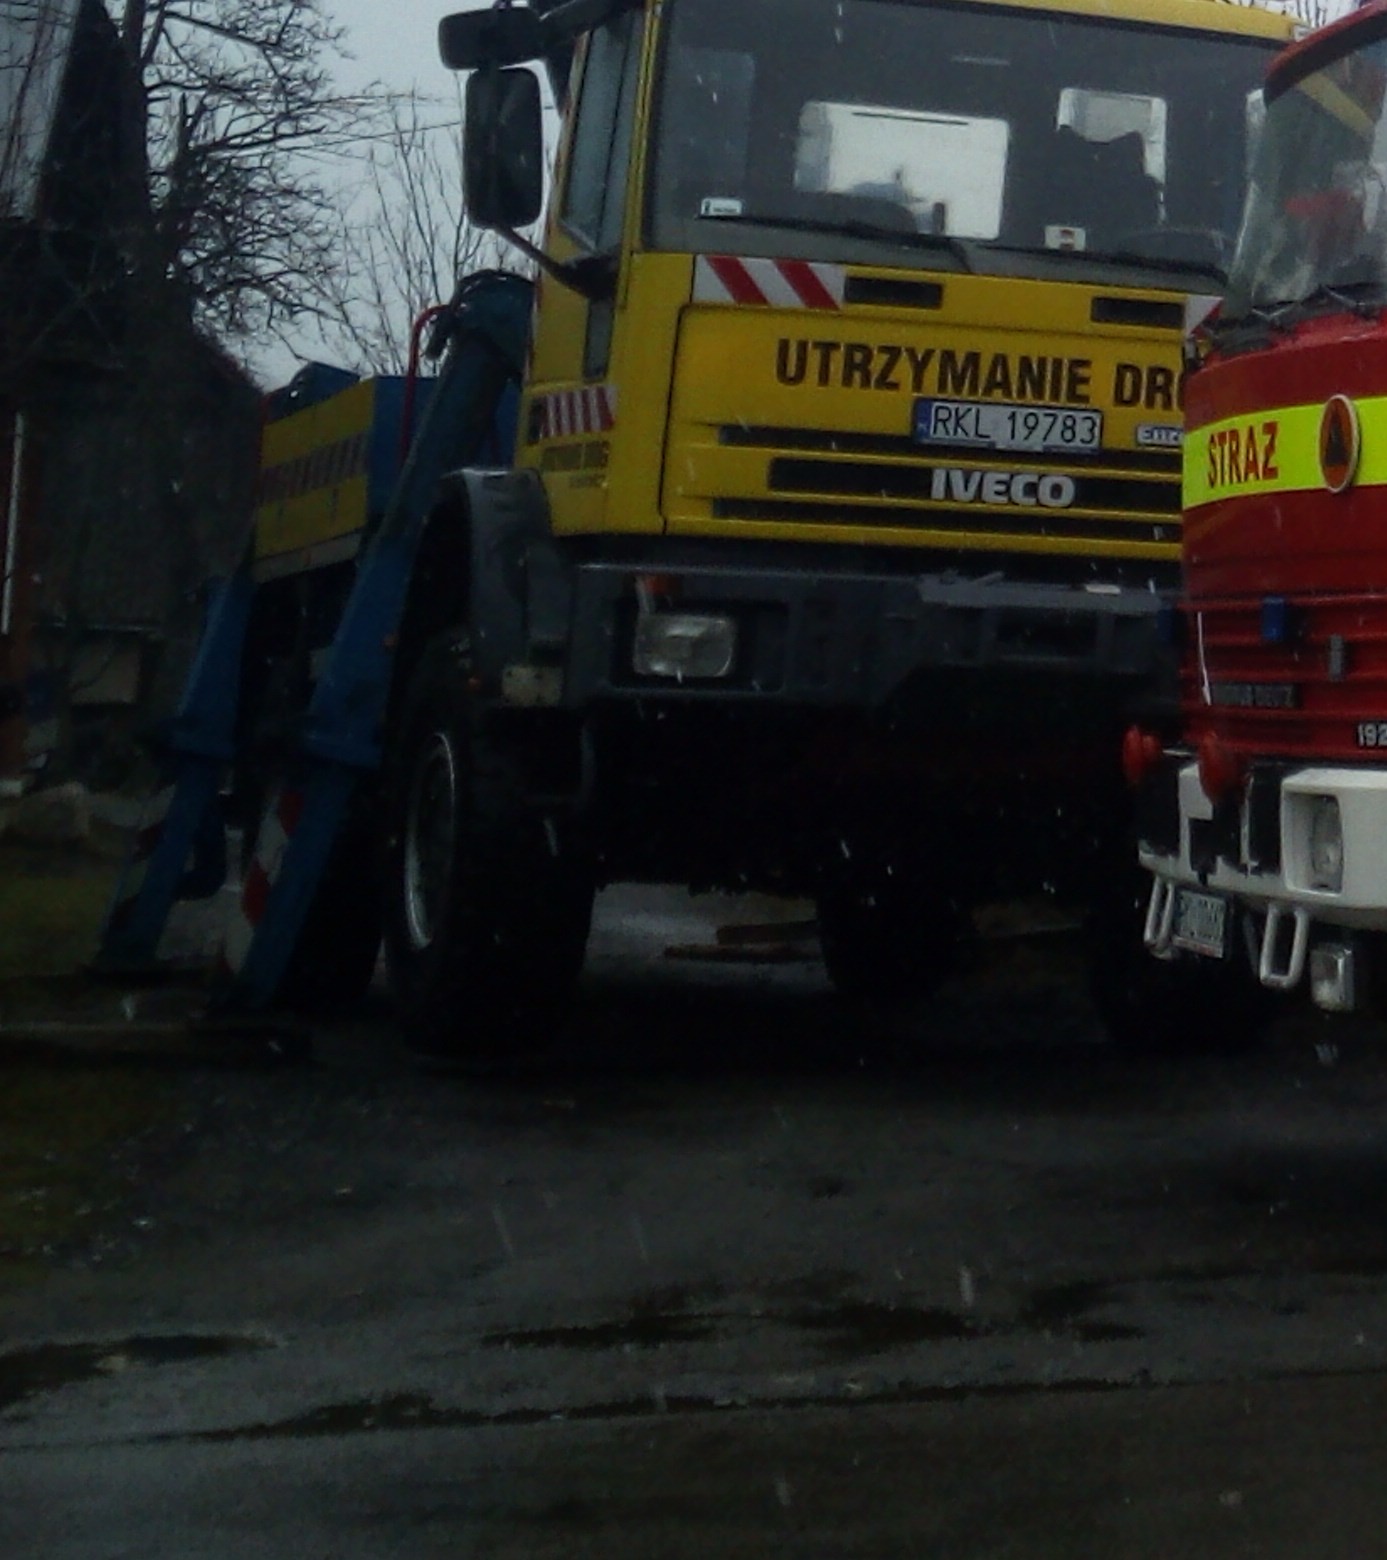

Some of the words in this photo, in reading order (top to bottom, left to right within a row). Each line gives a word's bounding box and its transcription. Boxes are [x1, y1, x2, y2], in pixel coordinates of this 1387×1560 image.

[775, 338, 1092, 404] UTRZYMANIE
[1113, 362, 1184, 411] DR
[931, 405, 991, 440] RKL
[1007, 410, 1098, 446] 19783
[930, 467, 1076, 509] IVECO
